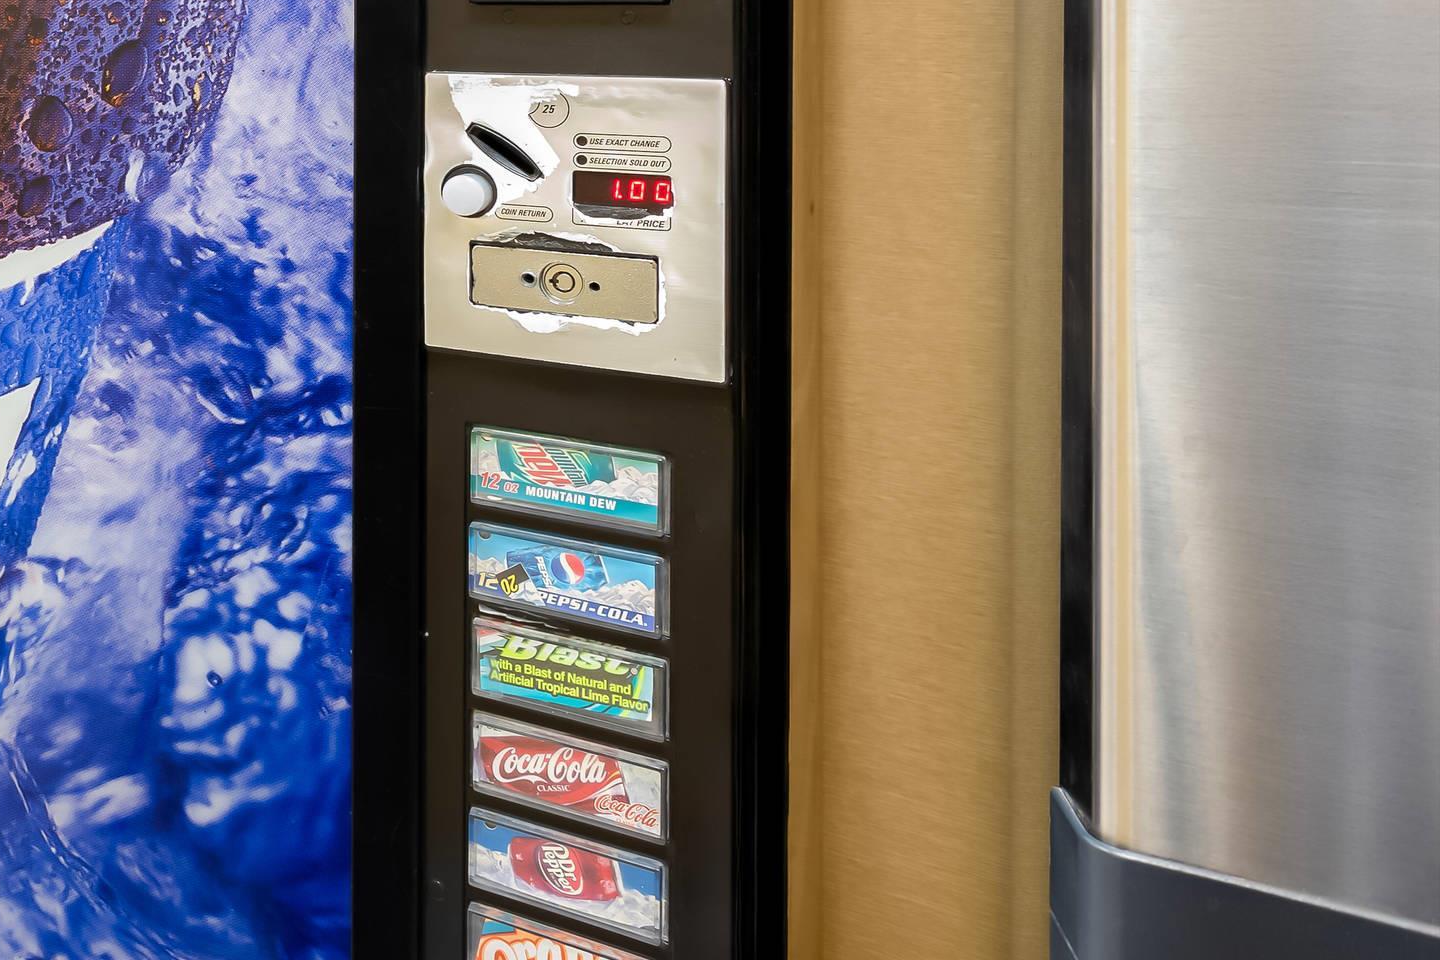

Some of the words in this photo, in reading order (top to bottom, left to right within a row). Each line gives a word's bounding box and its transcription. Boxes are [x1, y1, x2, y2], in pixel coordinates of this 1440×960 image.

[542, 105, 556, 115] 25
[605, 138, 629, 146] EXACT
[630, 140, 661, 148] CHANGE
[589, 157, 628, 166] SELECTION
[650, 160, 667, 168] OUT
[501, 208, 517, 216] COIN
[518, 209, 547, 218] RETURN
[637, 220, 666, 229] PRICE
[481, 472, 501, 490] 12
[526, 486, 586, 506] MOUNTAIN
[589, 498, 617, 511] DEW
[491, 658, 513, 672] with
[515, 664, 521, 673] a
[524, 664, 551, 680] Blast
[554, 670, 565, 682] of
[568, 674, 607, 690] Natural
[610, 684, 631, 696] and
[491, 671, 533, 688] Artificial
[536, 678, 579, 698] Tropical
[582, 688, 609, 704] Lime
[612, 695, 648, 712] Flavor
[493, 746, 608, 784] Coca-Cola
[537, 785, 570, 793] CLASSIC
[594, 794, 659, 828] Coca-Cola
[541, 846, 575, 892] Pepper
